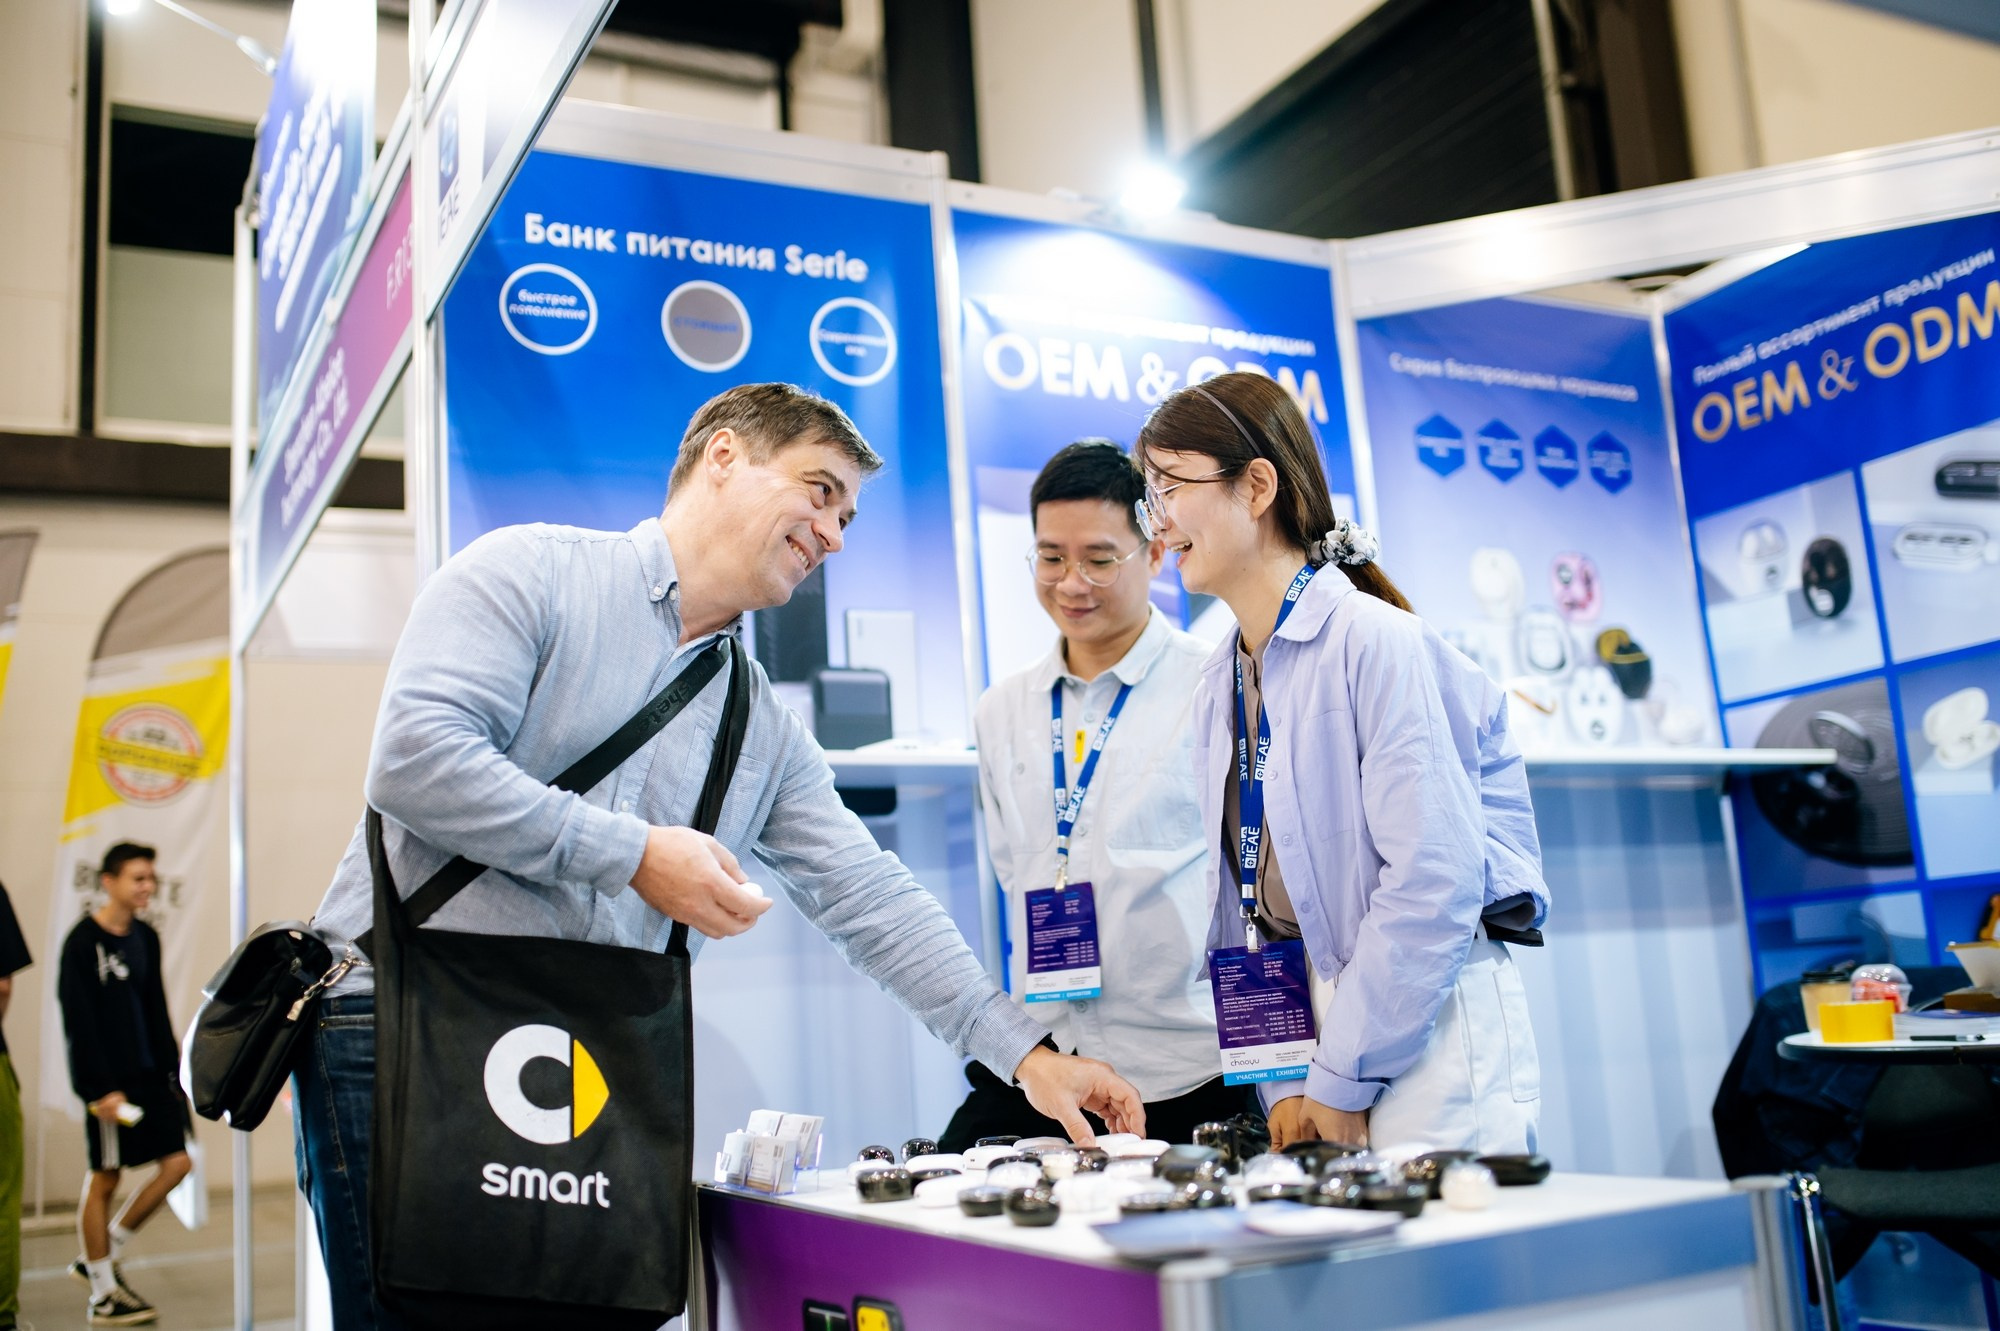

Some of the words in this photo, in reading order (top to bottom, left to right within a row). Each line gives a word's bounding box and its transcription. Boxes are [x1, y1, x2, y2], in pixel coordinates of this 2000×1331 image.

[524, 212, 617, 253] Банк
[626, 231, 776, 272] питания
[784, 244, 869, 283] Serie
[518, 288, 578, 307] быстрое
[1757, 295, 1880, 358] ассортимент
[1883, 248, 1995, 308] продукции
[983, 332, 1130, 402] OEM
[1136, 351, 1180, 405] &
[1692, 360, 1811, 443] OEM
[1817, 349, 1859, 400] &
[1863, 280, 2000, 379] ODM
[1239, 751, 1249, 782] IEAE
[1255, 736, 1270, 770] IEAE
[1245, 826, 1260, 858] IEAE
[1231, 1059, 1260, 1067] chaoyu
[1236, 1072, 1268, 1081] УЧАСТНИК
[1276, 1068, 1308, 1077] EXHIBITOR
[480, 1162, 611, 1209] smart
